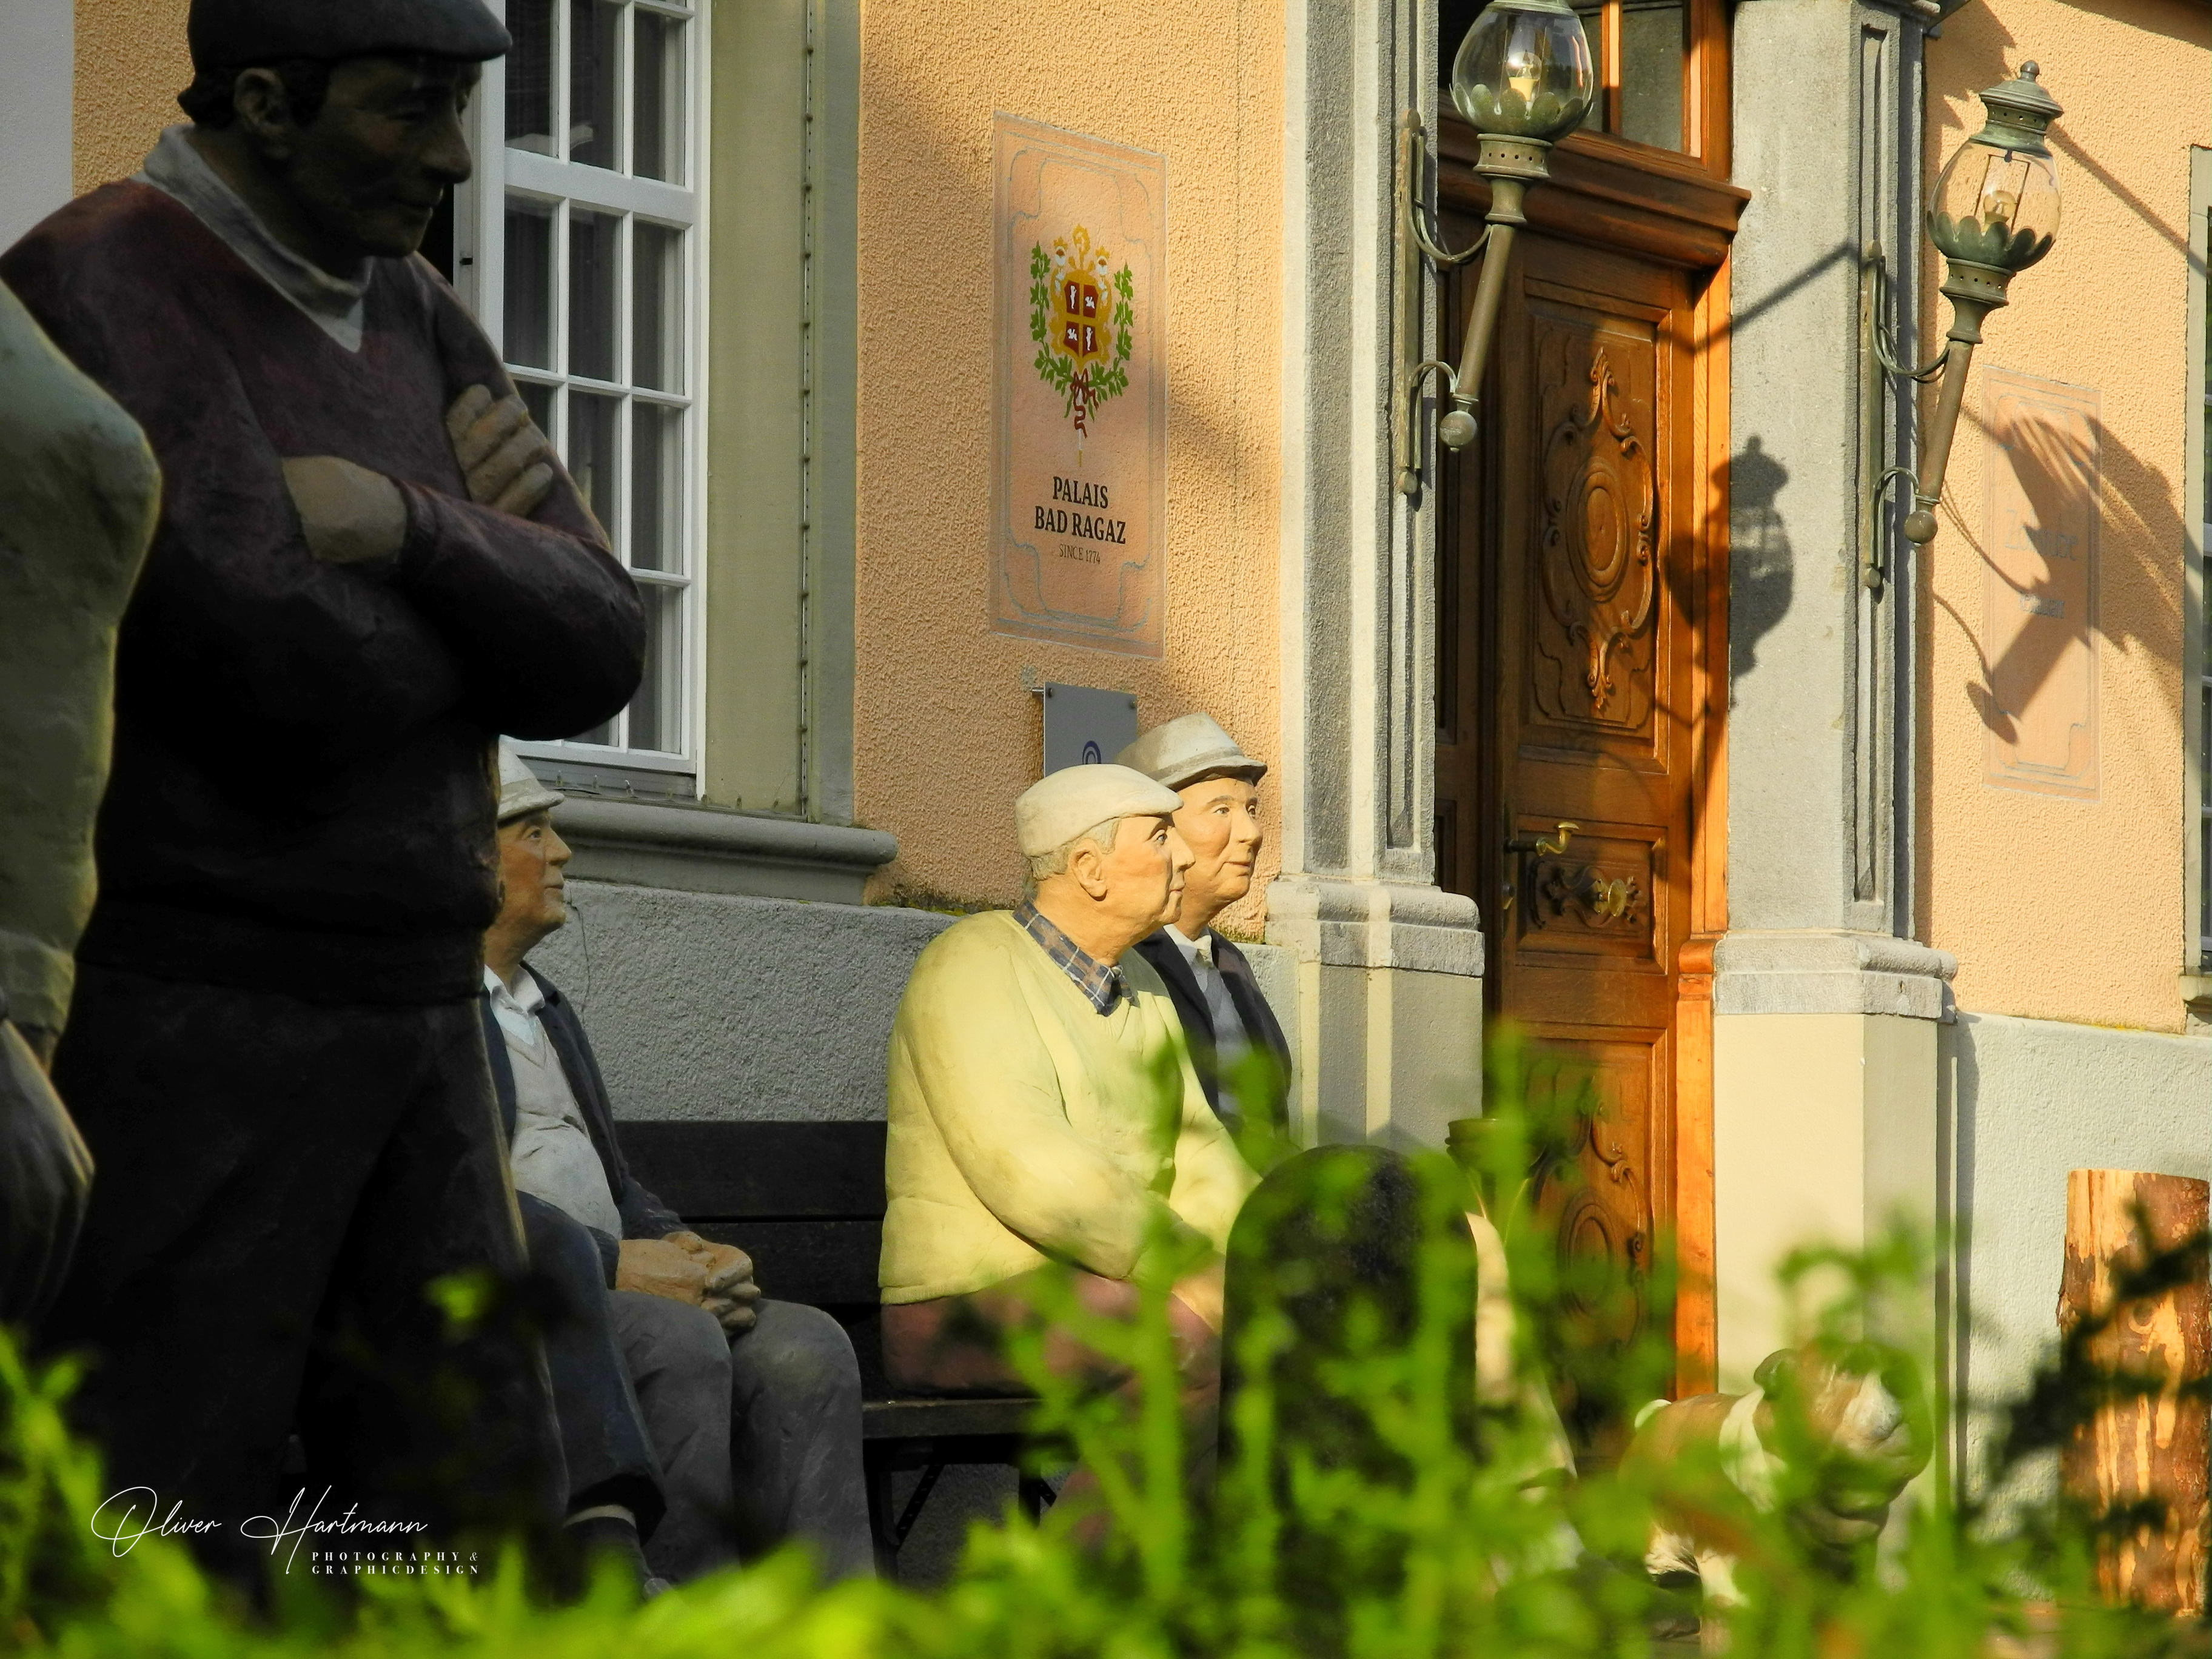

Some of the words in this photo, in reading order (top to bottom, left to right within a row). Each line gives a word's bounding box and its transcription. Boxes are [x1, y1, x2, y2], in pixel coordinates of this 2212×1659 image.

[1053, 476, 1108, 509] PALAIS
[1034, 506, 1068, 533] BAD
[1071, 512, 1126, 544] RAGAZ
[1059, 544, 1083, 560] SINCE
[1086, 550, 1101, 565] 1774
